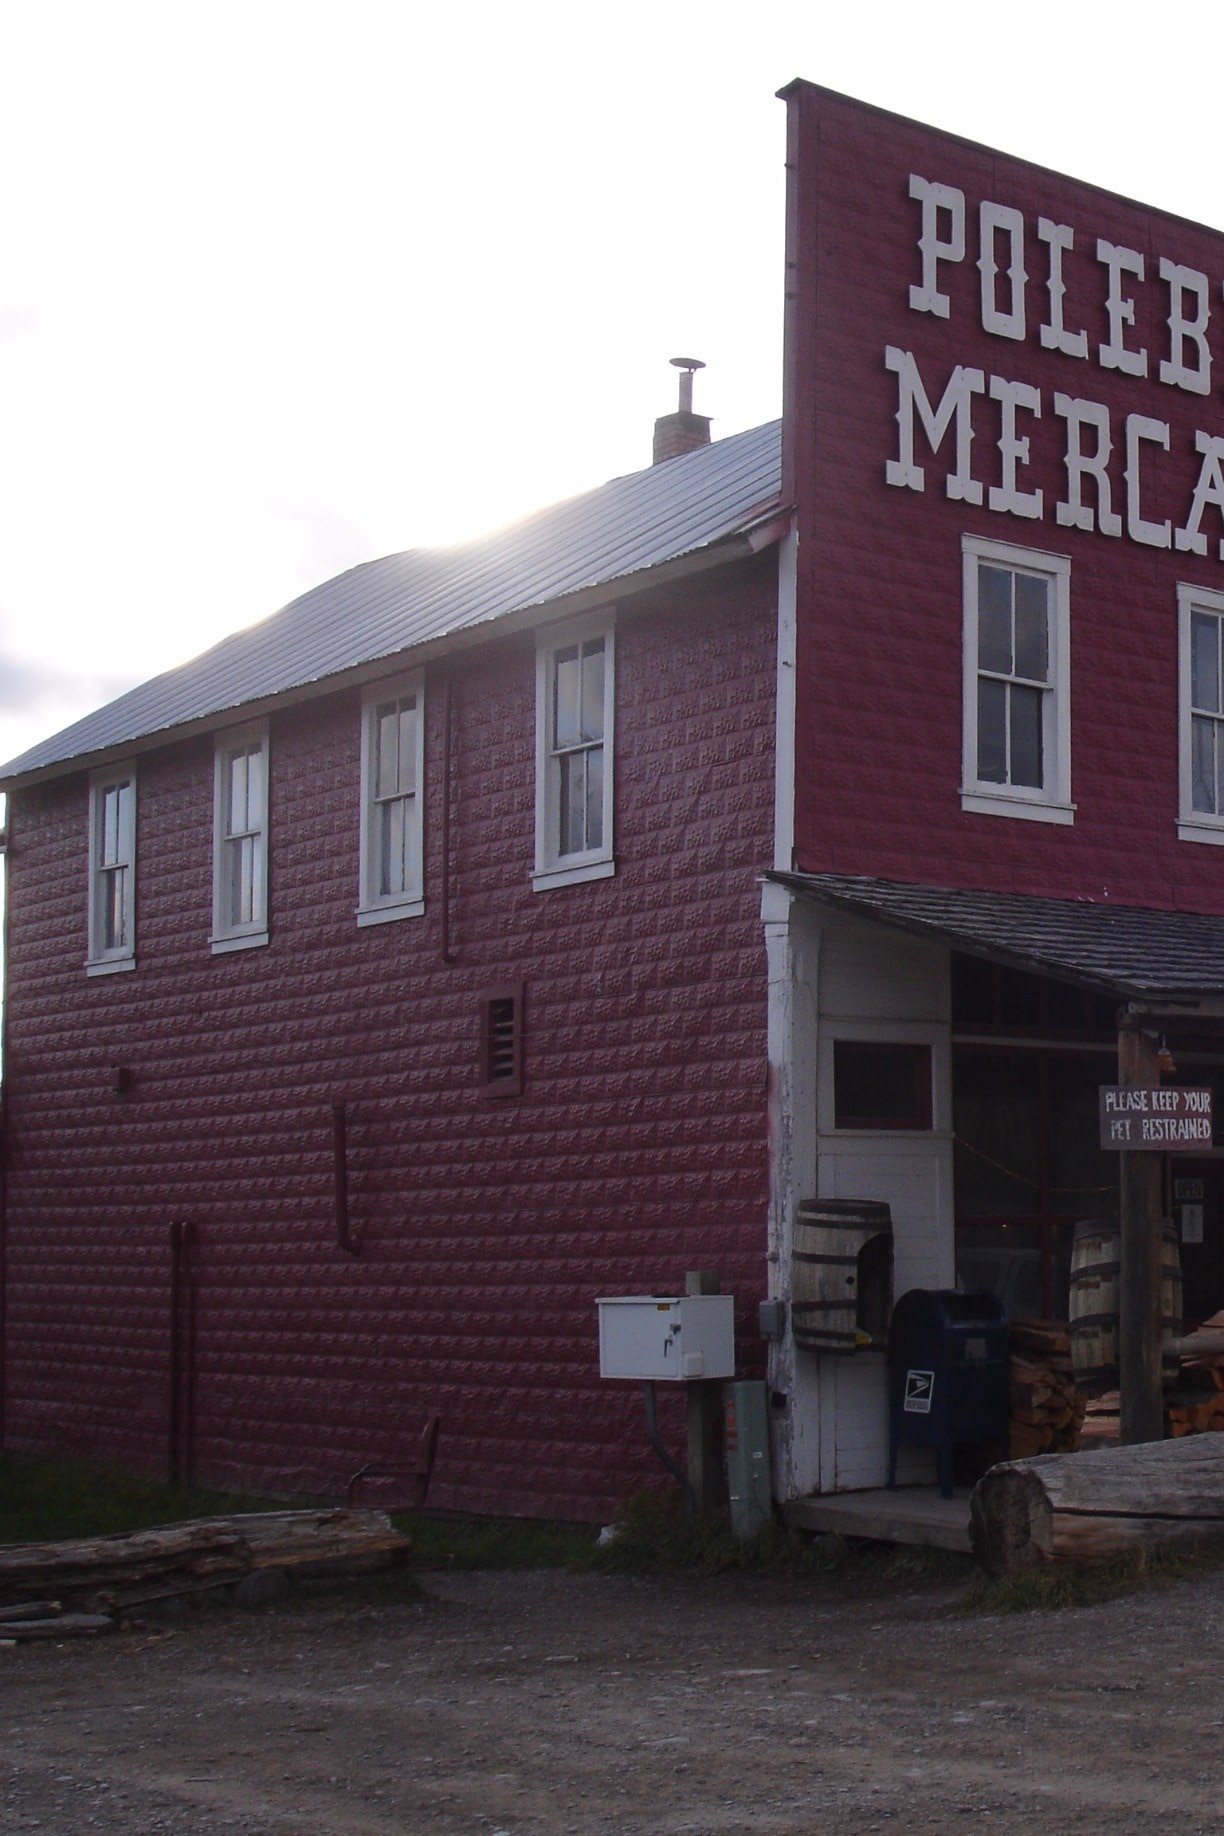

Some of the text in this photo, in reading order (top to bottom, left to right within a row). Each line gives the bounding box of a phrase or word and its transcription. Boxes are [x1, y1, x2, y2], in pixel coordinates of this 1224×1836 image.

[1105, 1090, 1211, 1113] PLEASE KEEP YOUR
[1111, 1117, 1211, 1140] PET RESTRAINED
[1177, 1181, 1202, 1197] OPEN
